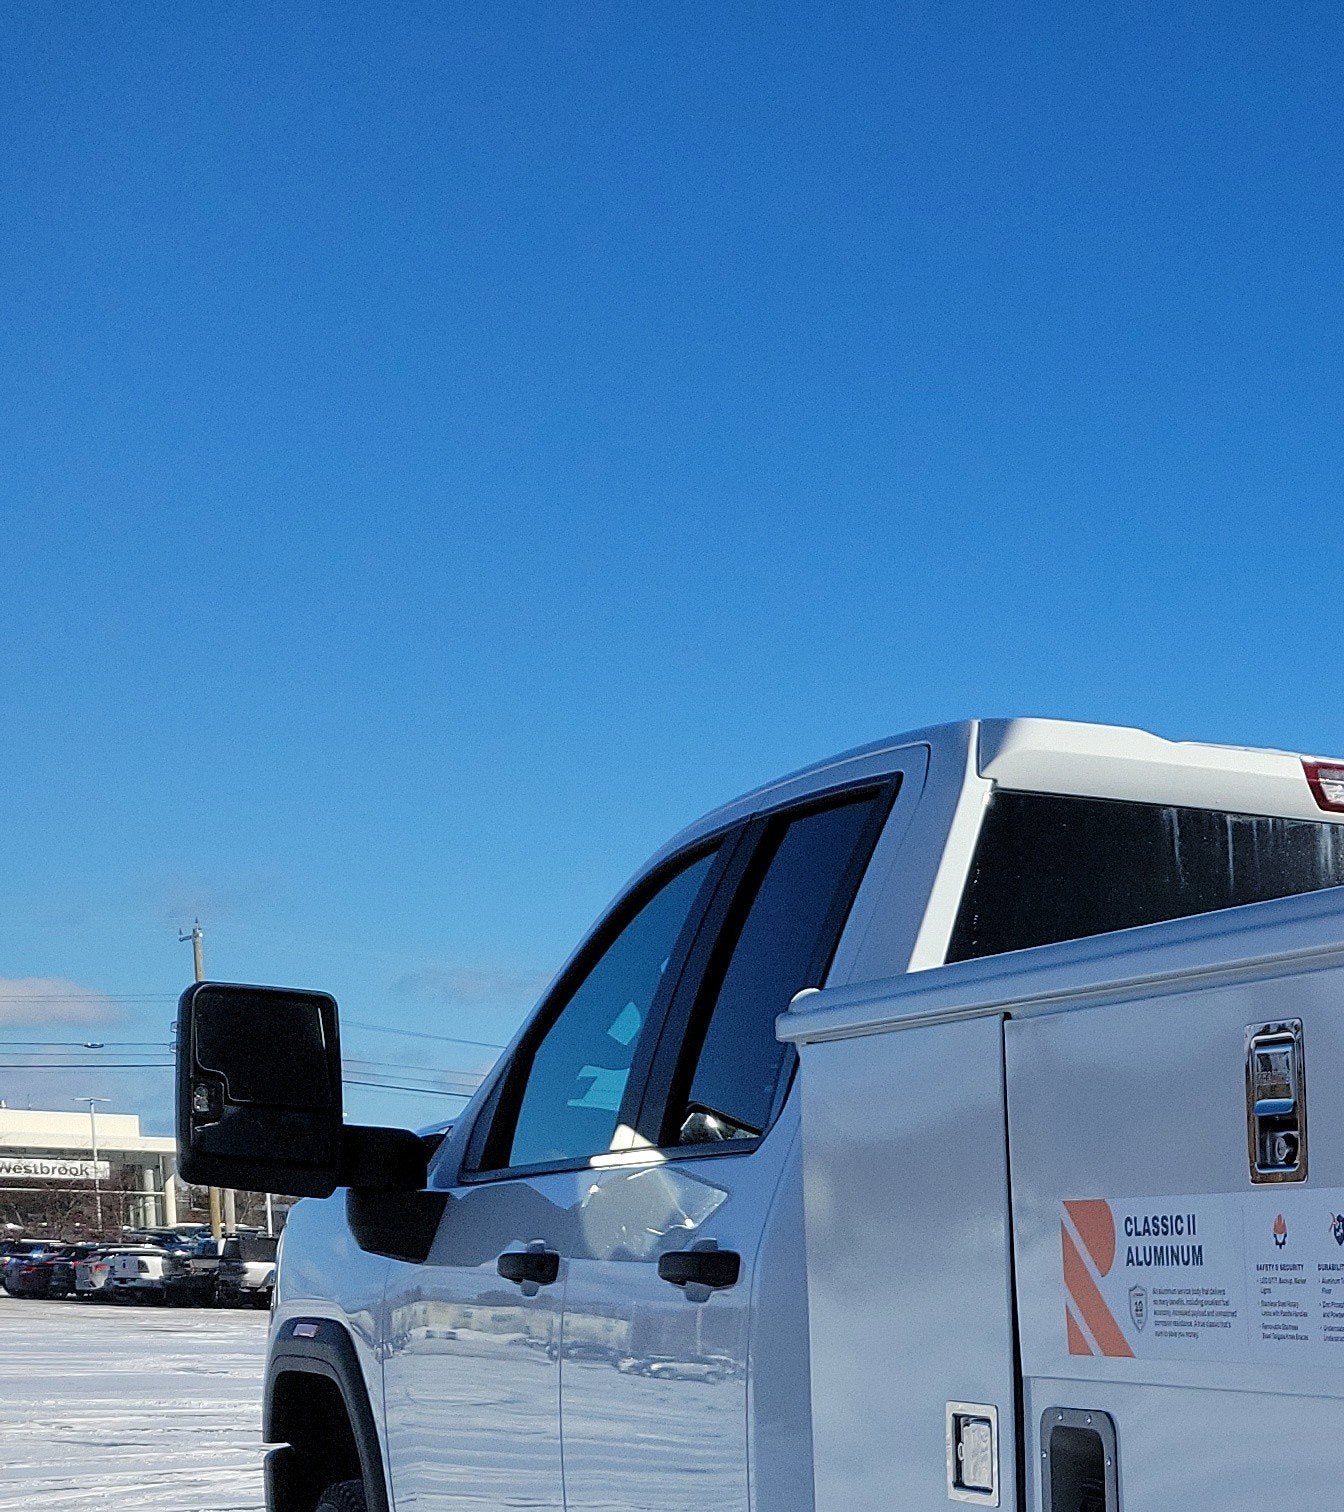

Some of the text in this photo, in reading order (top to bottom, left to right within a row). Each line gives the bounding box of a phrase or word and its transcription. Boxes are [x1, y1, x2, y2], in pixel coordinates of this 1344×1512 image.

[0, 1162, 90, 1177] Westbrook
[1124, 1213, 1197, 1237] CLASSIC II
[1125, 1245, 1204, 1267] ALUMINUM
